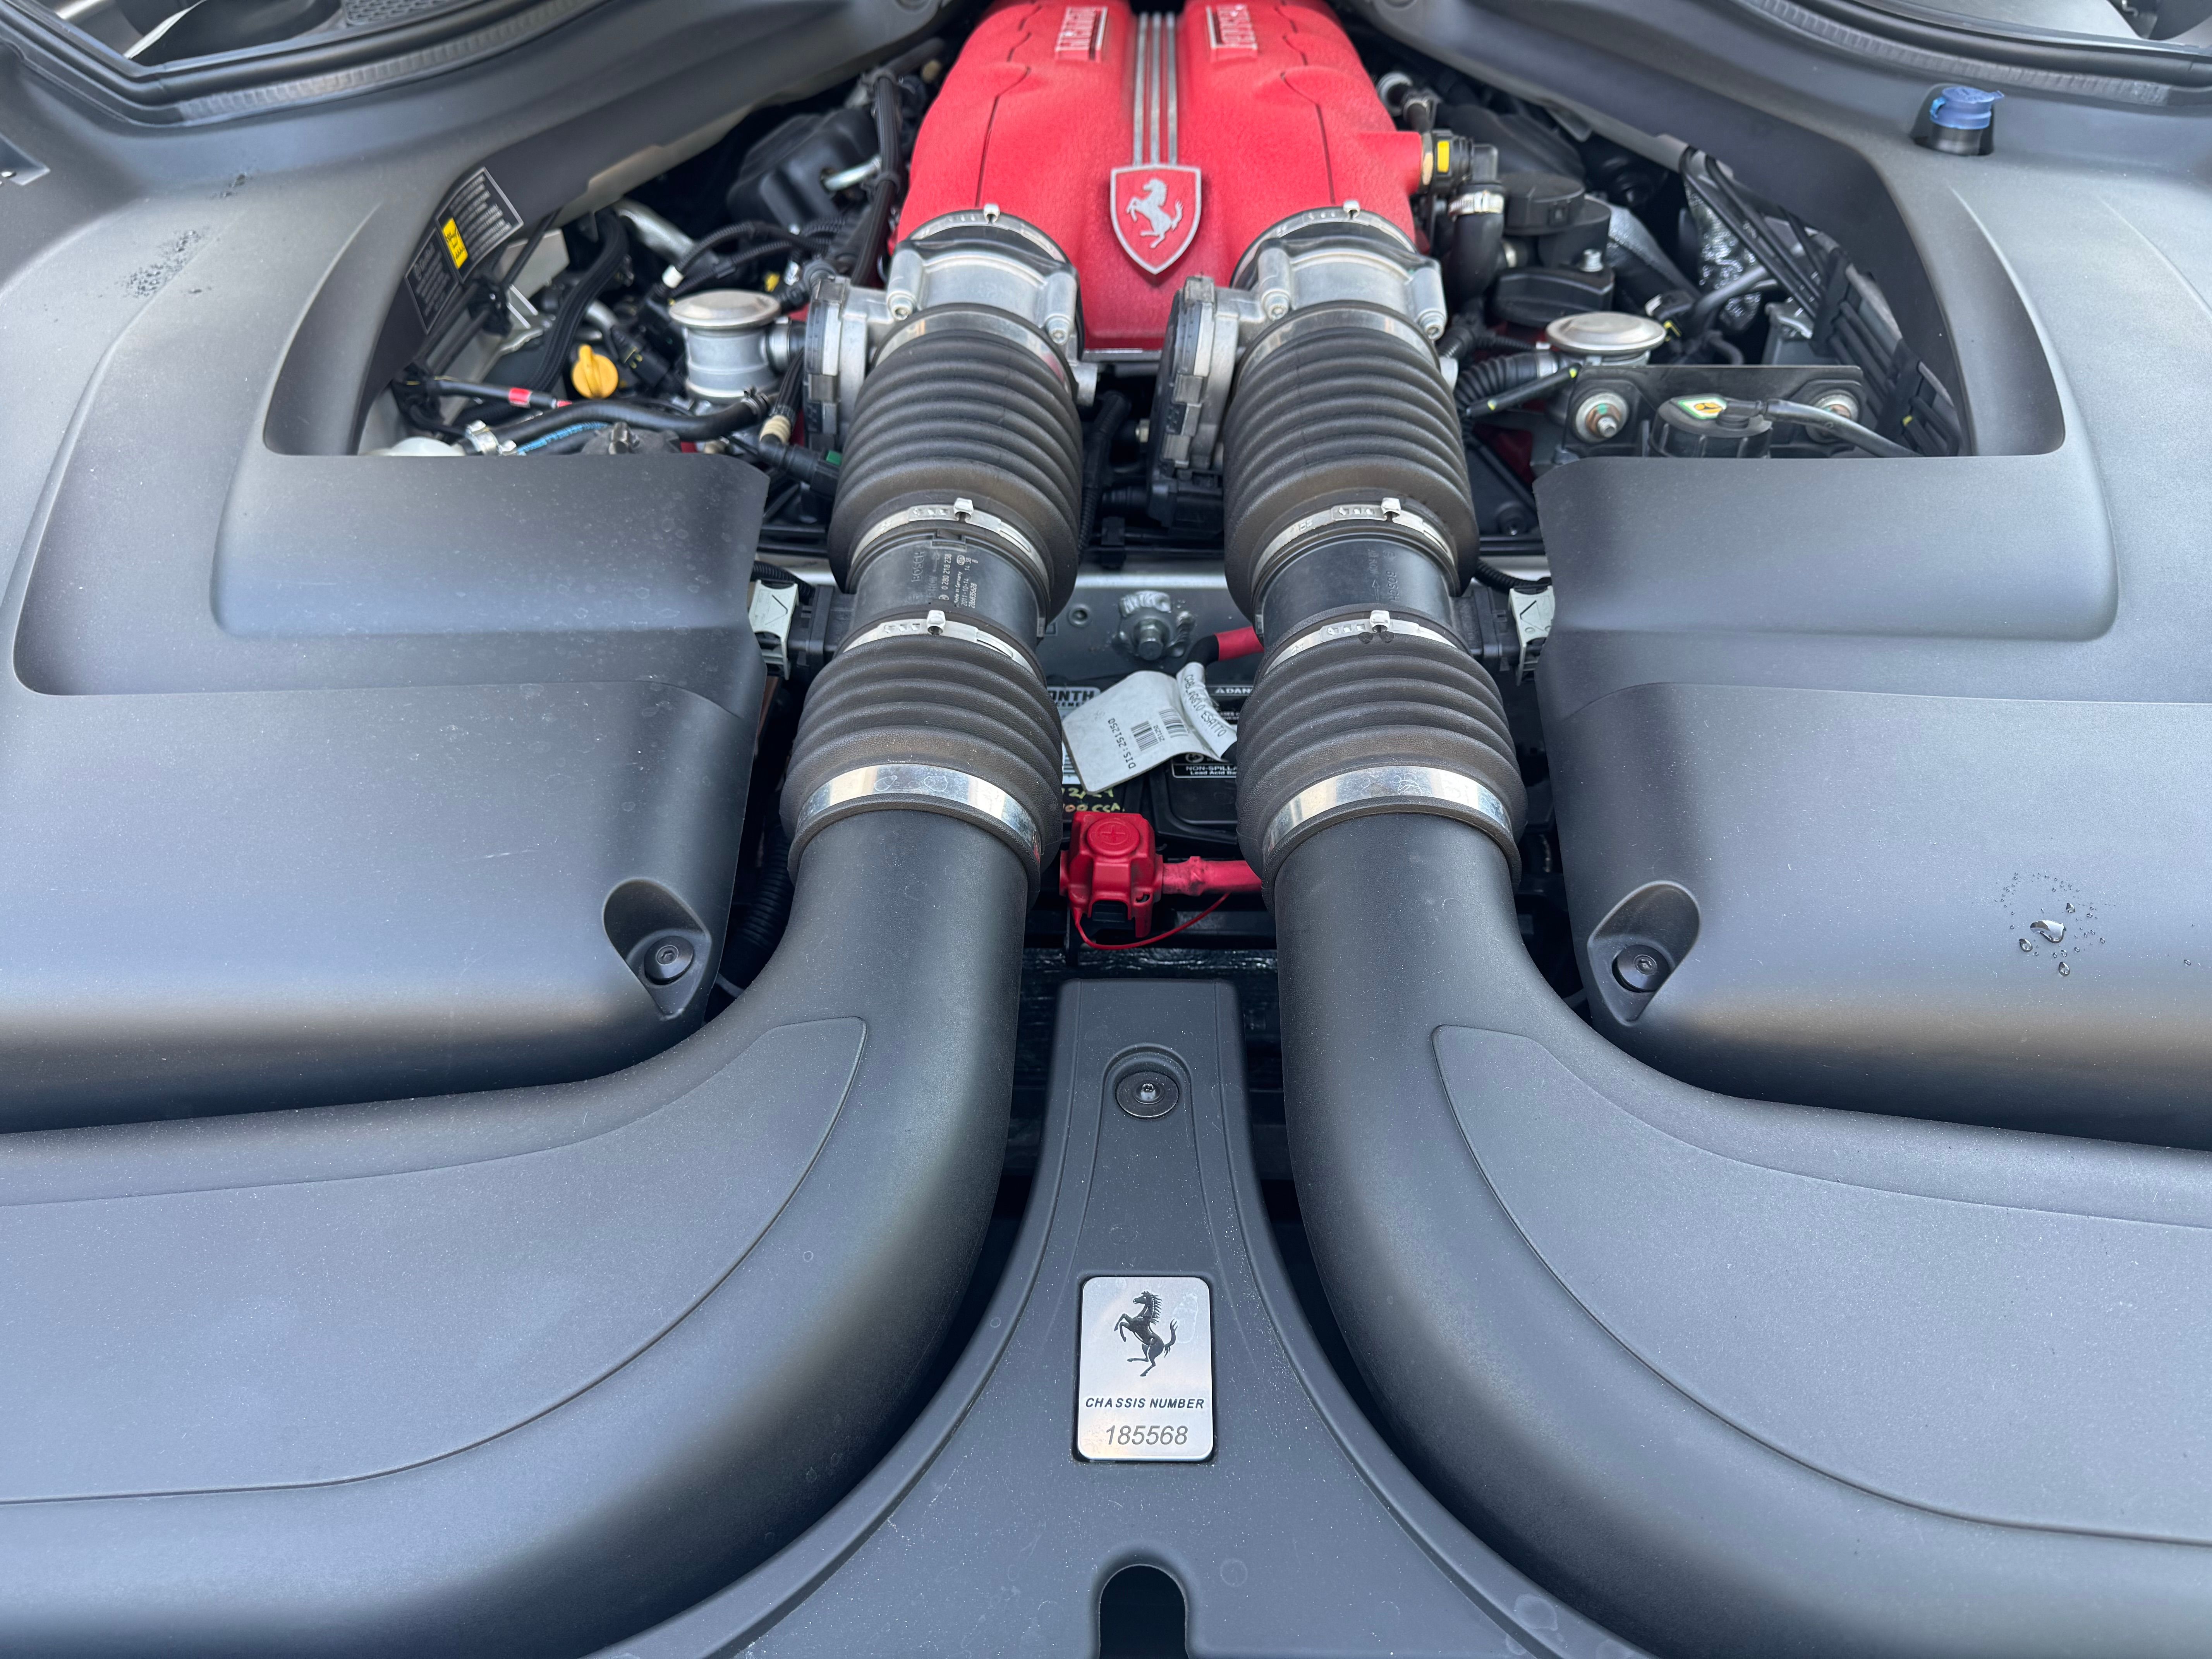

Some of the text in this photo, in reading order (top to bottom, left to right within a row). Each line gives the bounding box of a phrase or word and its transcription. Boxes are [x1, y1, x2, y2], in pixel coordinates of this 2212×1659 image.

[911, 552, 924, 582] BOSCH
[943, 565, 951, 574] 218
[955, 571, 963, 588] Germany
[1386, 570, 1400, 603] BOSCH
[1201, 709, 1227, 737] ESATTO
[1108, 718, 1136, 769] DIS:251250
[1063, 804, 1088, 812] 00
[1085, 1397, 1204, 1409] CHASSIS NUMBER
[1106, 1425, 1188, 1445] 185568
